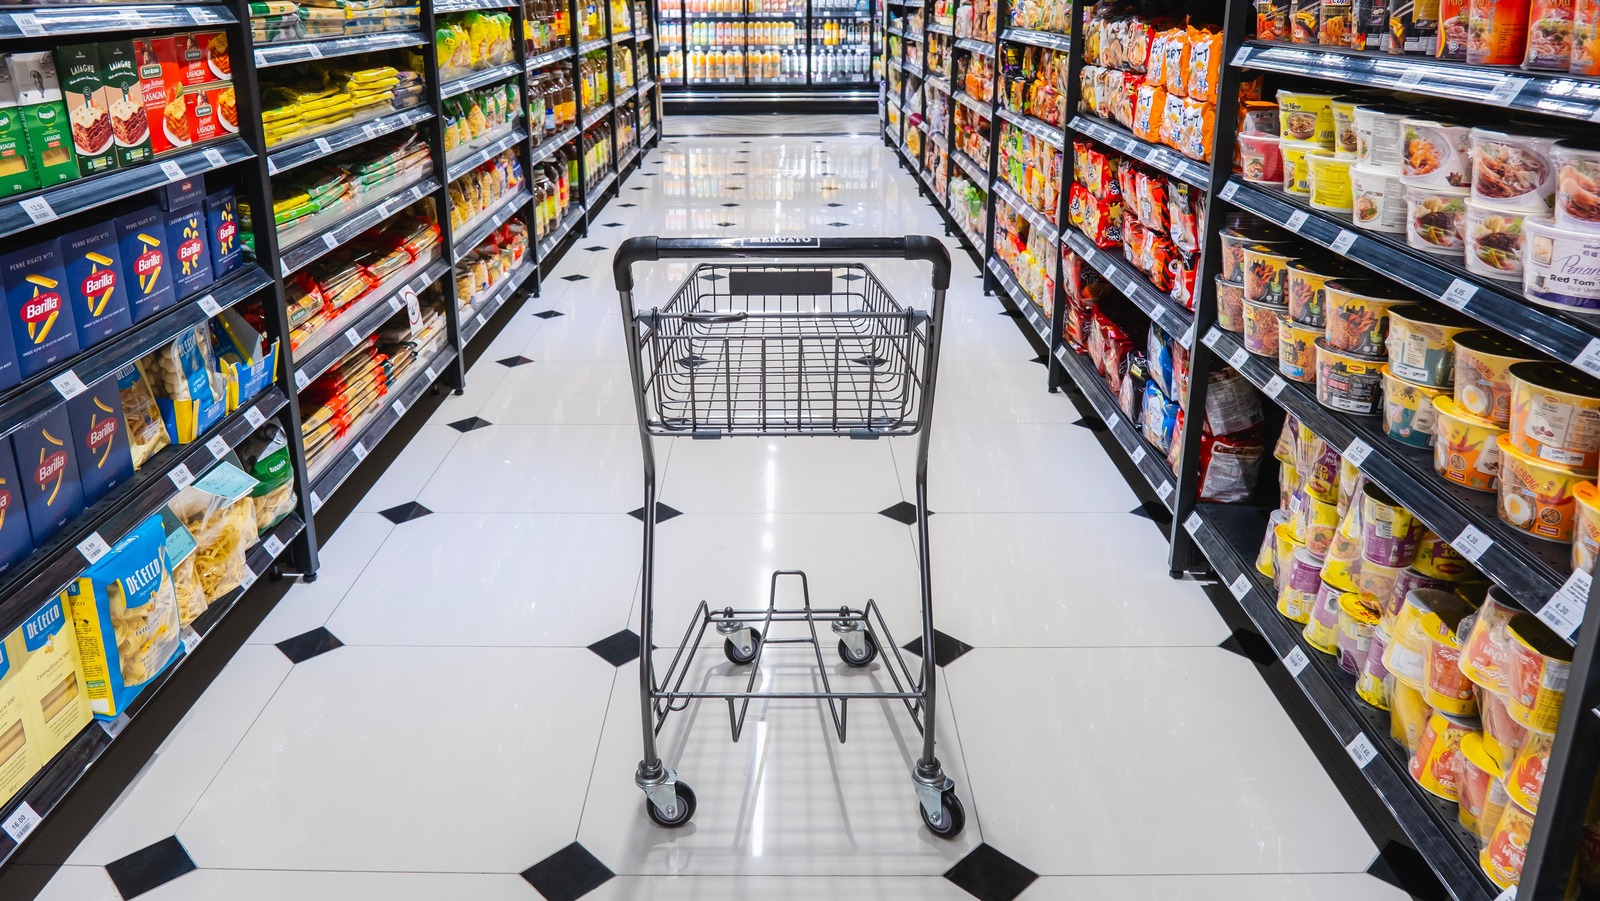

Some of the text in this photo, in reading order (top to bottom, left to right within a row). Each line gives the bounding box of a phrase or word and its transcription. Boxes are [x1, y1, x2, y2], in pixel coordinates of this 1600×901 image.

[70, 64, 95, 76] LASAGNE
[109, 60, 131, 71] LASAGNE
[143, 91, 166, 102] LASAGNA
[181, 242, 201, 259] Barilla
[9, 251, 54, 271] PENNE RIGATE N°73
[138, 254, 161, 272] Barilla
[86, 274, 114, 294] Barilla
[1550, 274, 1595, 287] Red Tom
[27, 297, 59, 319] Barilla
[90, 421, 115, 446] Barilla
[39, 455, 65, 482] Barilla
[1466, 534, 1478, 545] 4.30
[125, 577, 138, 596] DE
[137, 558, 161, 589] CECCO
[1555, 603, 1569, 615] 4.30
[26, 604, 60, 640] DE CECCO
[11, 814, 26, 830] 16.00
